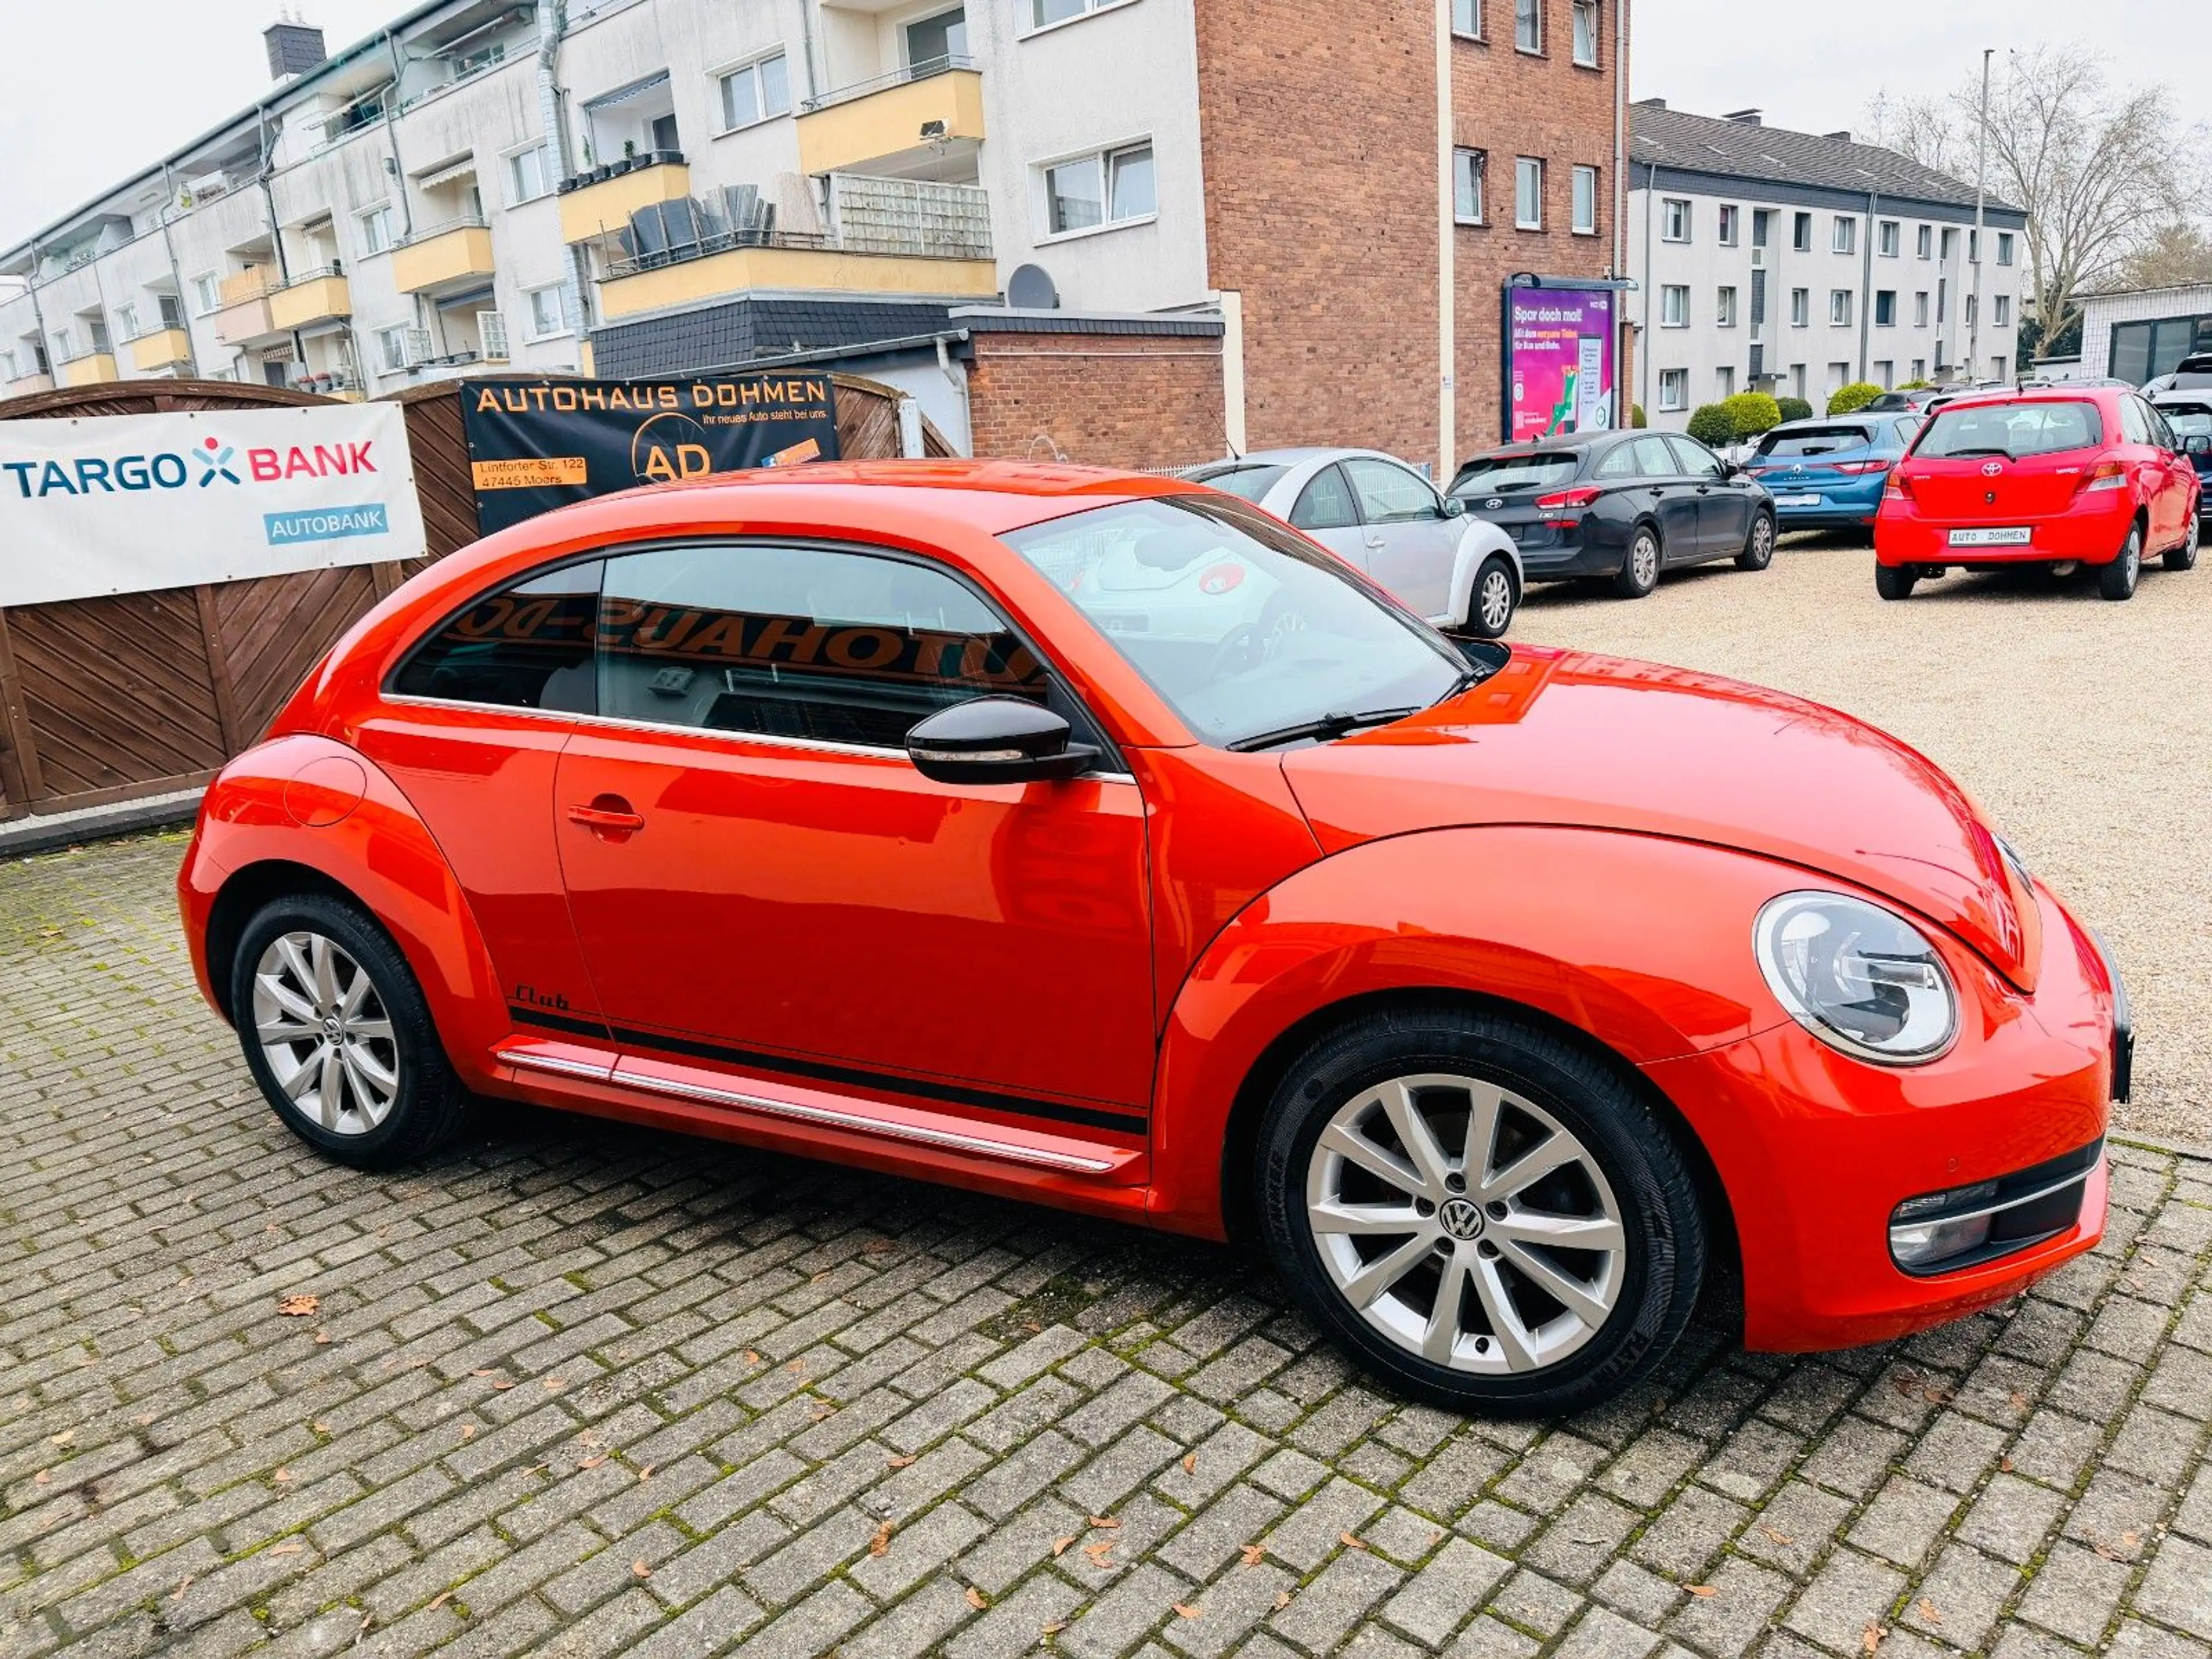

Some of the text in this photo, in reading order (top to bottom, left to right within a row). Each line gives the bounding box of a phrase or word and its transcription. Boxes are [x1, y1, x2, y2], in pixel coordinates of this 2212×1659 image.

[1515, 306, 1537, 324] Spar
[1539, 307, 1562, 322] doch
[477, 380, 825, 412] AUTOHAUS DOHMEN
[718, 415, 748, 424] neues
[749, 411, 768, 422] Auto
[770, 410, 793, 421] steht
[794, 410, 807, 419] bei
[2, 441, 378, 498] TARGO BANK
[480, 459, 584, 473] Lintforter Str. 122
[645, 444, 710, 480] AD
[482, 475, 562, 487] 47445 Moers
[272, 511, 382, 539] AUTOBANK
[1952, 531, 2027, 541] AUTO DOHMEN
[515, 984, 569, 1010] Club
